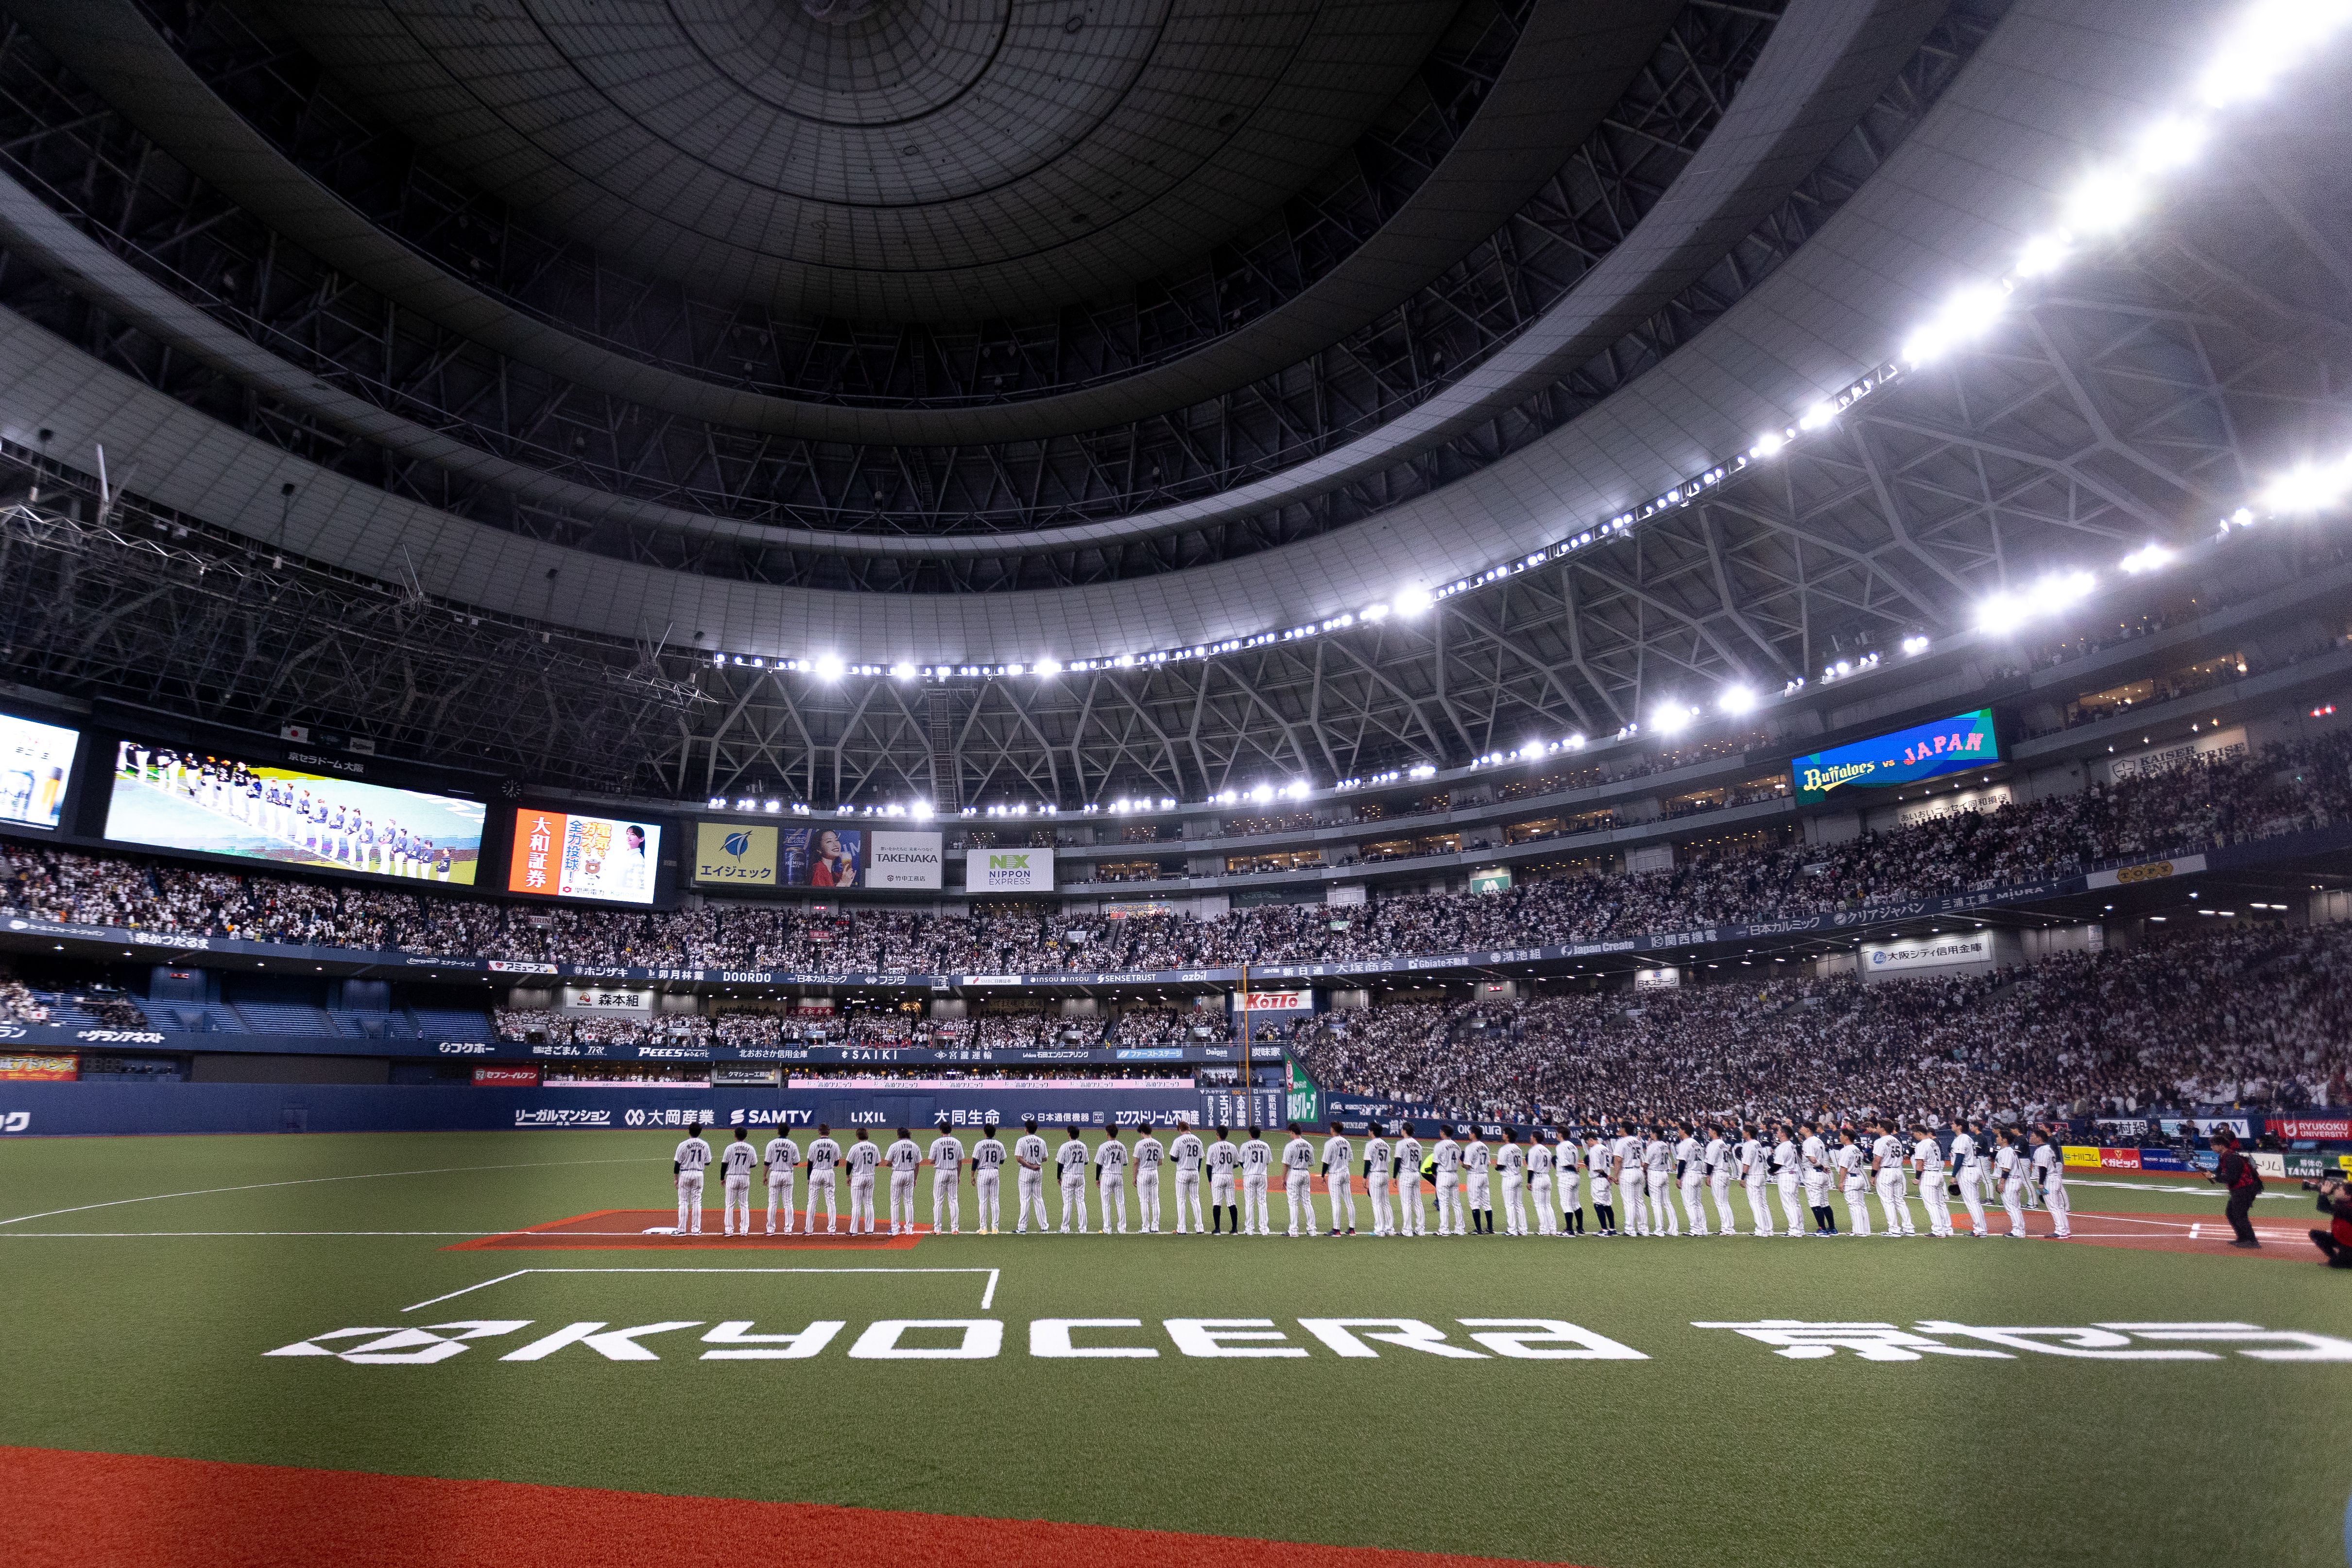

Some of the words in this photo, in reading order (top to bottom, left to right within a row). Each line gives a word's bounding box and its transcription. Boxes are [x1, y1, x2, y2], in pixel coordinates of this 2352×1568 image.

[2139, 745, 2196, 765] KAISER
[288, 752, 364, 773] 京セラドーム大阪
[1803, 761, 1875, 791] Buffaloes
[1904, 733, 1983, 765] JAPAN
[1901, 793, 2007, 822] あいおいニッセイ同和損保
[525, 816, 552, 888] 大和証券
[876, 854, 938, 863] TAKENAKA
[701, 865, 772, 879] エイジェック
[2119, 862, 2173, 881] TOPY
[574, 887, 605, 896] 関西電力
[1941, 894, 1990, 909] 三浦工業
[529, 916, 551, 924] KIRIN
[1847, 903, 1925, 924] クリアジャパン
[1750, 917, 1820, 935] 日本カルミック
[135, 931, 209, 949] 串かつだるま
[1665, 930, 1717, 947] 関西機電
[1602, 941, 1634, 951] Create
[1888, 943, 1982, 961] 大阪シティ信用金庫
[1503, 949, 1541, 961] 鴻池組
[584, 966, 628, 978] ホシザキ
[1283, 966, 1324, 976] 新日通
[1335, 961, 1394, 973] 大塚商会
[658, 969, 704, 981] 卯月林業
[723, 972, 772, 982] DOORDO
[797, 975, 847, 983] 日本カルミック
[879, 976, 907, 985] フジタ
[1182, 971, 1207, 982] azbil
[1637, 977, 1677, 987] 日本ステージ
[598, 994, 639, 1007] 森本組
[739, 1049, 808, 1058] 北おおさか信用金庫
[852, 1050, 897, 1060] SAIKI
[1131, 1050, 1182, 1058] ファーストステージ
[1206, 1048, 1227, 1056] Daigas
[1252, 1047, 1281, 1057] 炭味家
[515, 1109, 611, 1121] リーガルマンション
[648, 1109, 715, 1125] 大岡産業
[748, 1110, 812, 1124] SAMTY
[851, 1111, 886, 1124] LIXIL
[934, 1109, 1000, 1125] 大同生命
[1037, 1113, 1089, 1122] 日本通信機器
[1219, 1095, 1229, 1127] エコリカ
[1115, 1110, 1200, 1126] エクスドリーム不動産
[2299, 1122, 2348, 1131] RYUKOKU
[691, 1149, 702, 1162] 71
[776, 1150, 789, 1163] 79
[817, 1149, 831, 1162] 84
[901, 1150, 913, 1163] 14
[943, 1147, 954, 1160] 15
[985, 1150, 997, 1163] 18
[1030, 1145, 1040, 1157] 19
[1147, 1149, 1159, 1161] 26
[1186, 1144, 1199, 1157] 28
[1252, 1151, 1263, 1163] 31
[1298, 1149, 1310, 1162] 46
[1339, 1147, 1348, 1159] 47
[1378, 1149, 1388, 1162] 57
[1409, 1149, 1419, 1162] 66
[1451, 1151, 1457, 1163] 4
[1891, 1146, 1901, 1158] 55
[735, 1153, 747, 1166] 77
[863, 1152, 873, 1165] 13
[1072, 1151, 1083, 1164] 22
[1111, 1151, 1121, 1164] 24
[1219, 1152, 1233, 1165] 30
[497, 1319, 1653, 1361] KYOCERA
